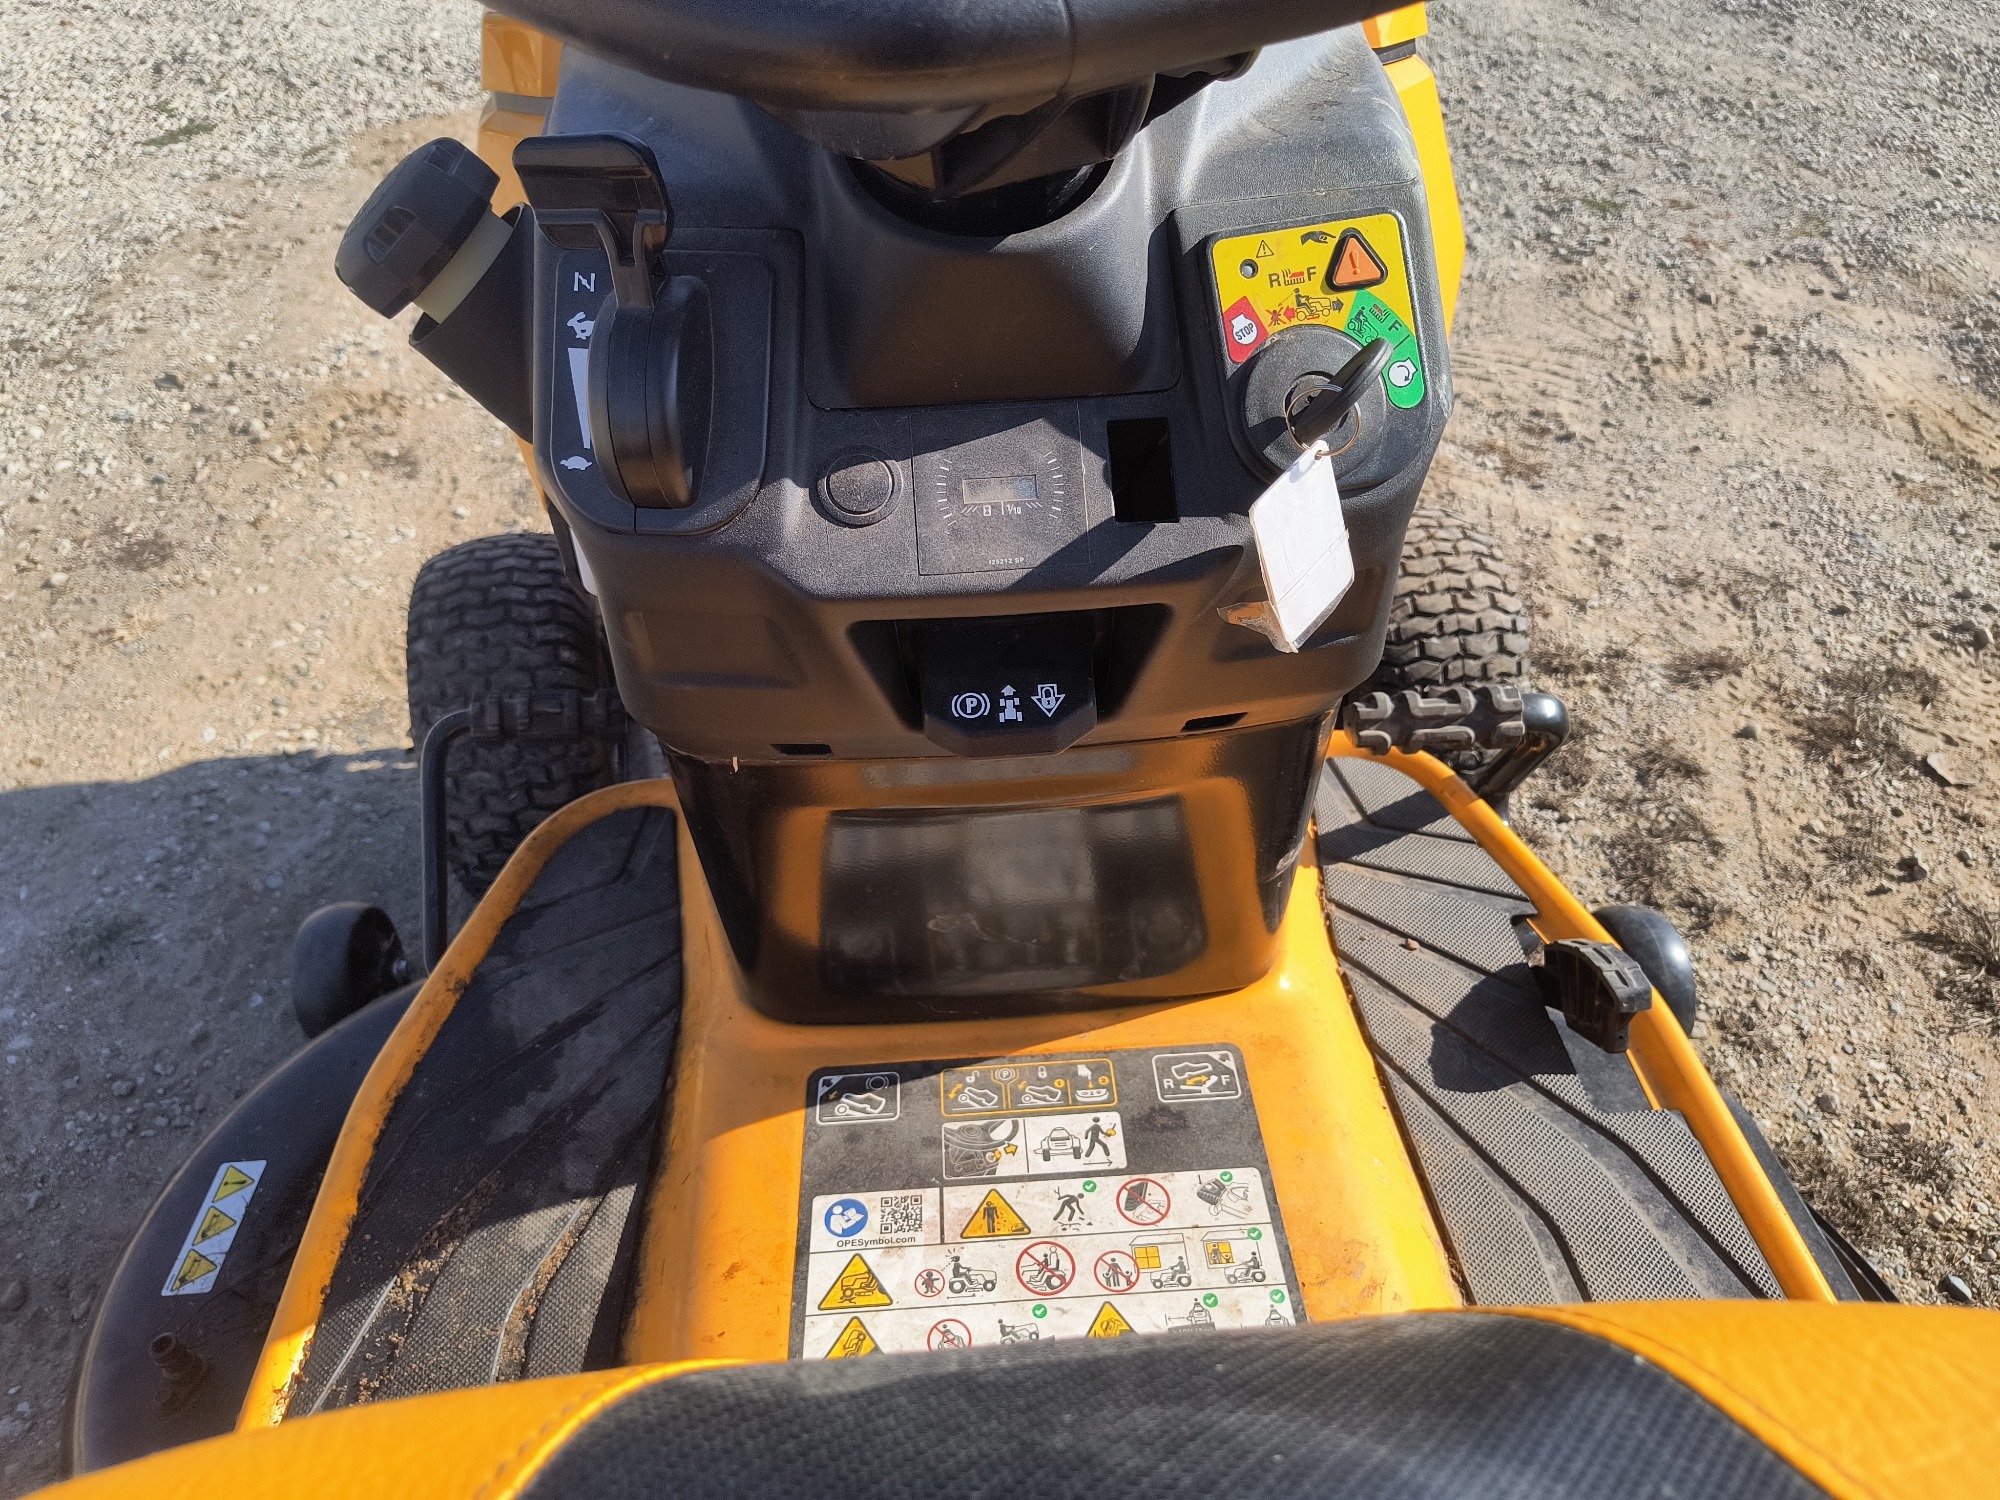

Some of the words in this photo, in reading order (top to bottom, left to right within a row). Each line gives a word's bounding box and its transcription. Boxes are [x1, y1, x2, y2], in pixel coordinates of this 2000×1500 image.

[1268, 273, 1281, 288] R
[1306, 266, 1317, 281] F
[1235, 322, 1254, 340] STOP
[1388, 319, 1403, 331] F
[1163, 1078, 1175, 1089] R
[1221, 1074, 1231, 1086] F
[836, 1236, 916, 1248] OPESymbol.com
